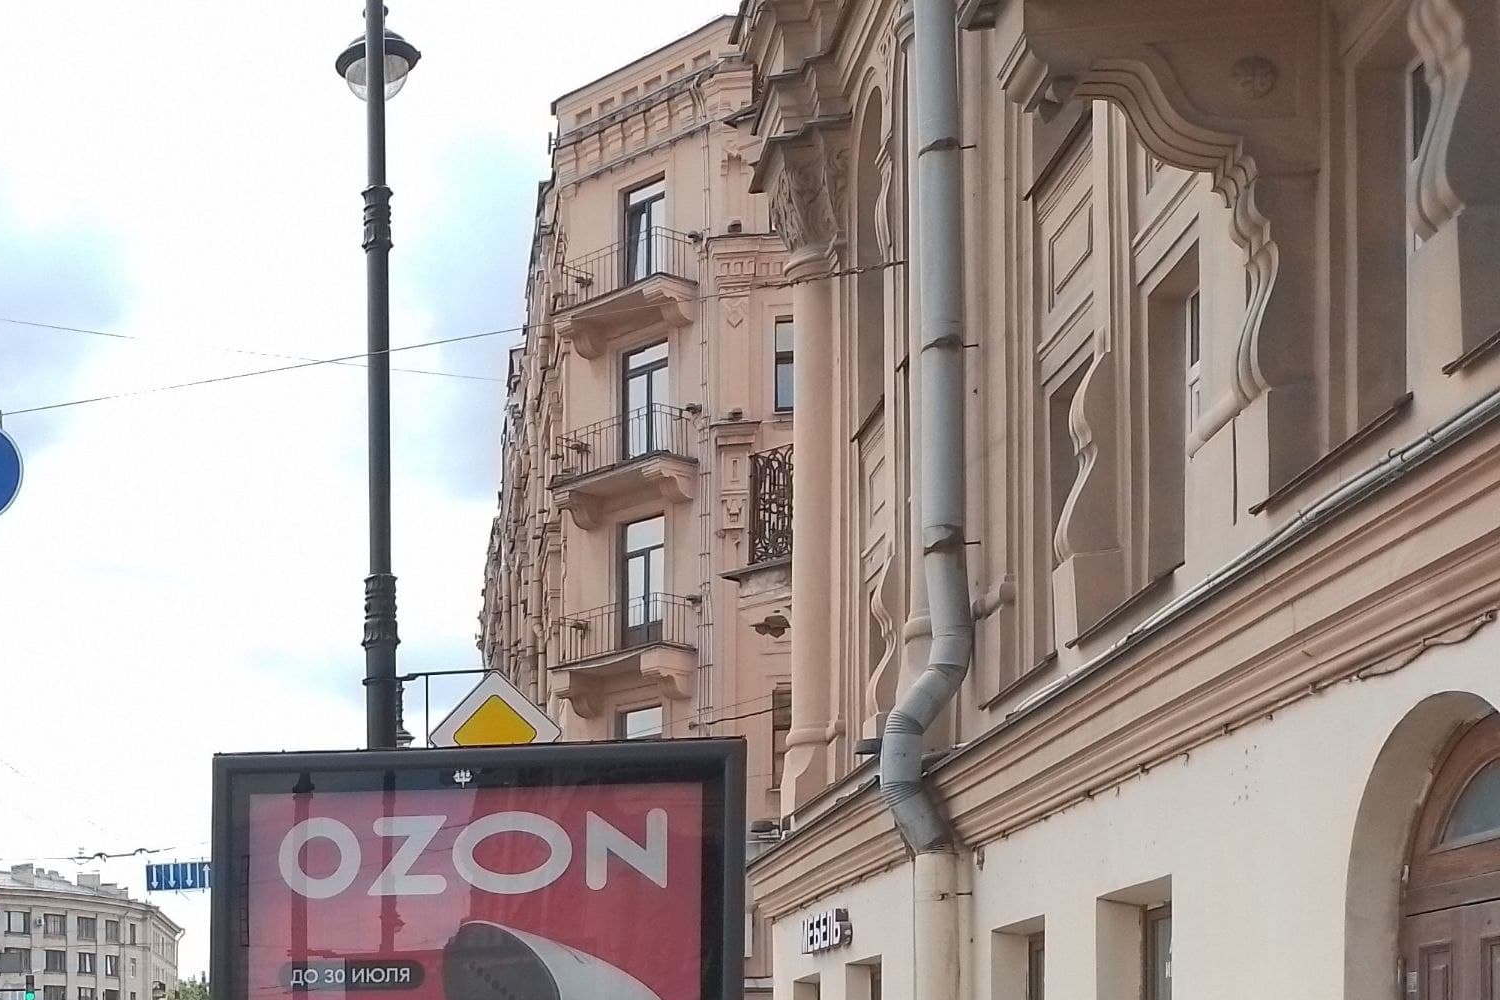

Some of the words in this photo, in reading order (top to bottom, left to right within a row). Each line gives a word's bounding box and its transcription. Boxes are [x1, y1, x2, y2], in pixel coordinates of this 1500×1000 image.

[279, 808, 668, 899] OZON
[290, 969, 319, 986] ДО
[324, 968, 346, 984] 30
[351, 967, 411, 983] ИЮЛЯ
